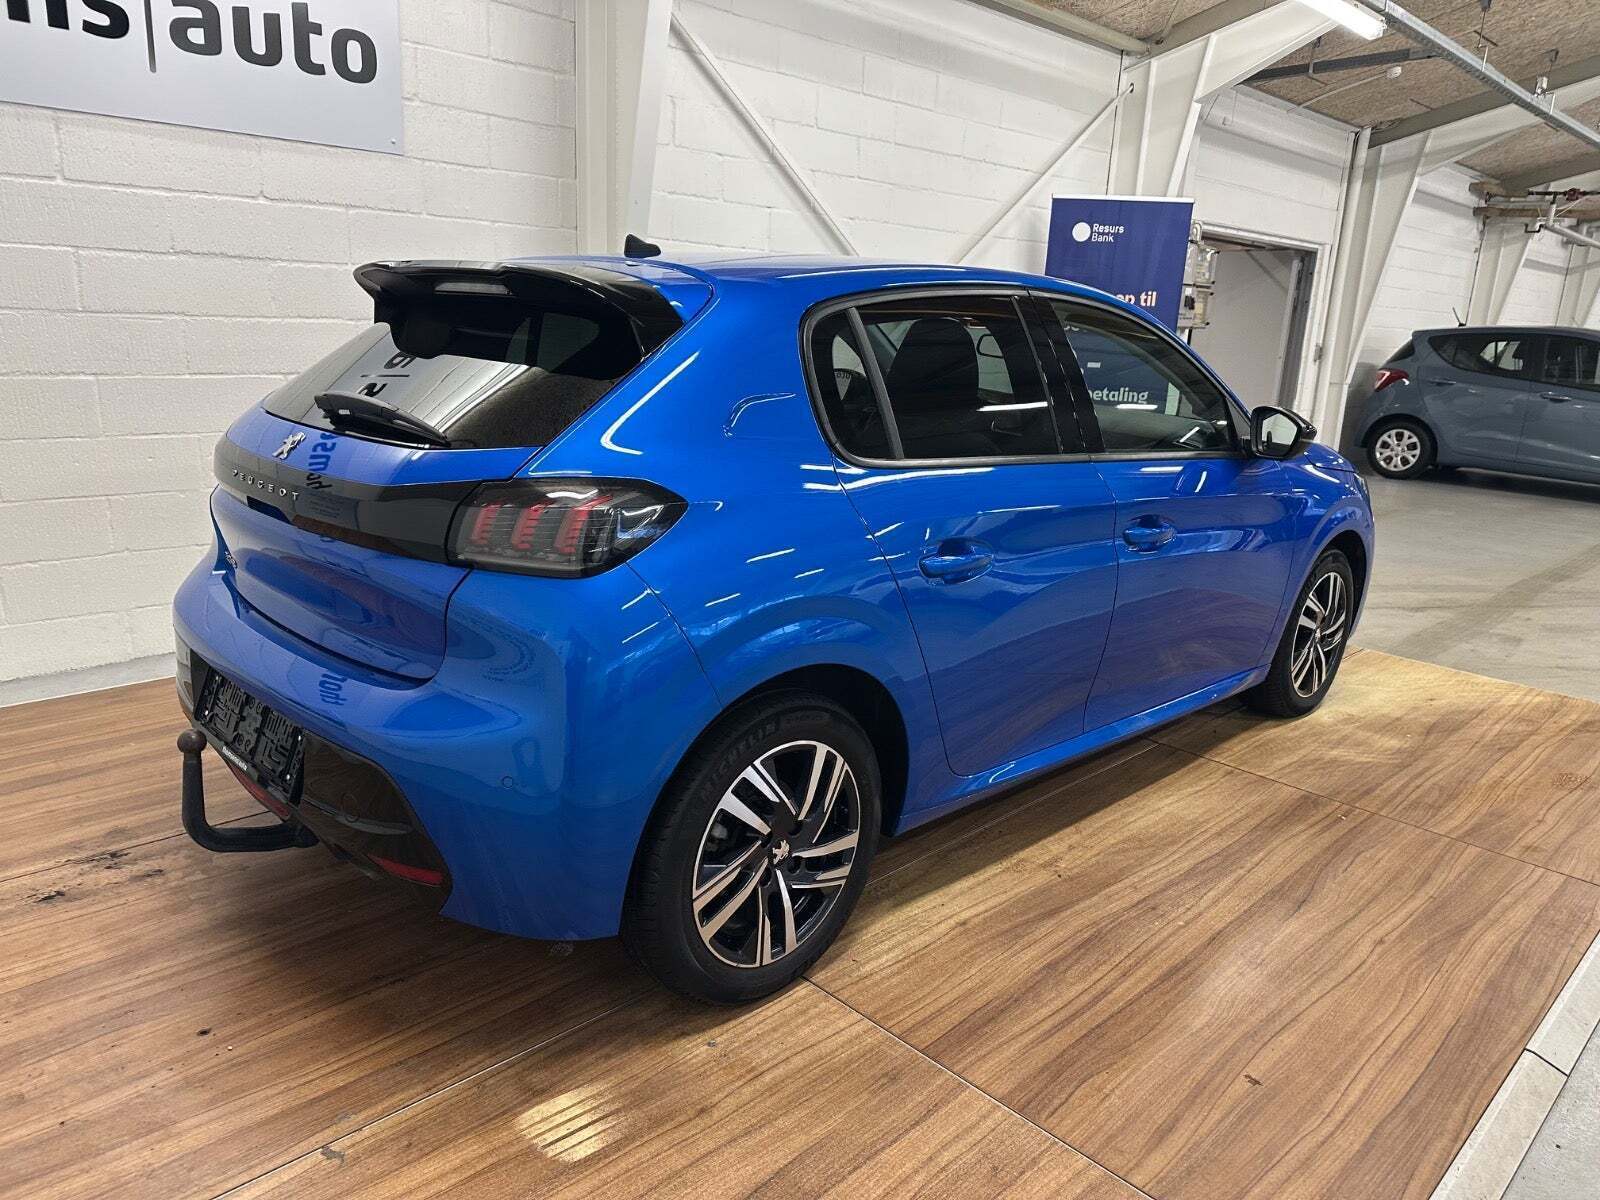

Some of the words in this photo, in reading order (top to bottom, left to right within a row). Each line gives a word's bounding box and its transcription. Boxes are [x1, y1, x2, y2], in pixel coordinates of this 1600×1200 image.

[1093, 223, 1125, 234] Resurs
[1091, 232, 1114, 243] Bank
[1139, 291, 1157, 306] til
[231, 468, 300, 501] PEUGEOT
